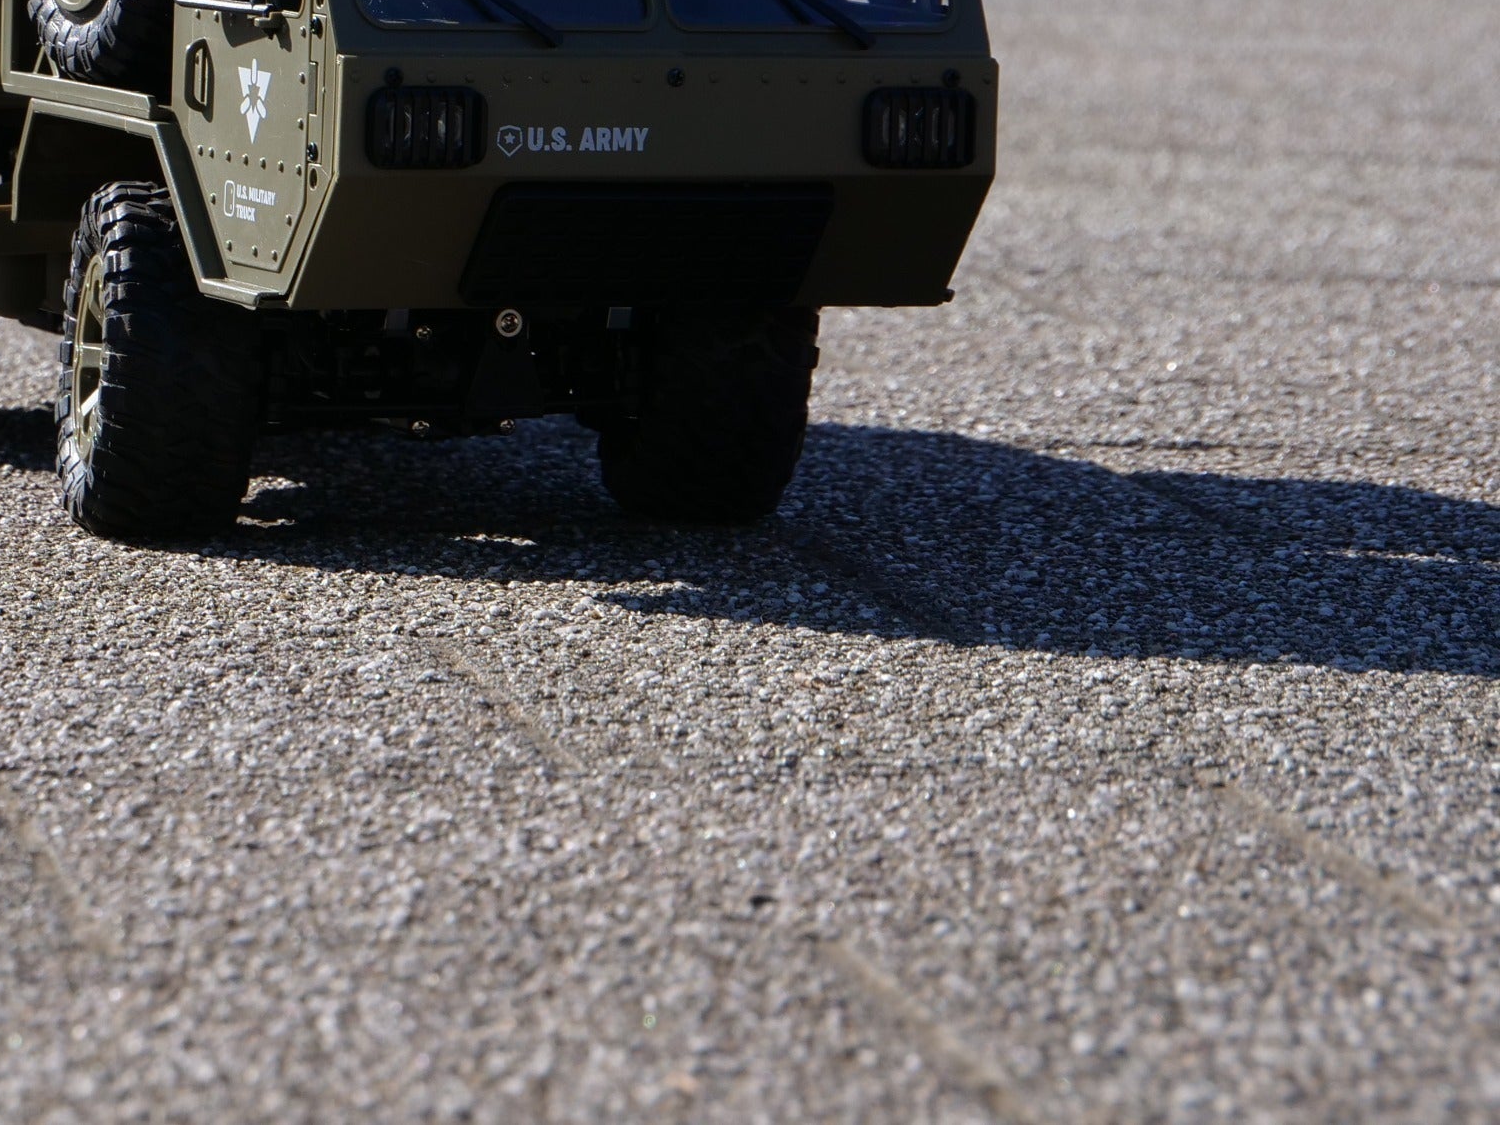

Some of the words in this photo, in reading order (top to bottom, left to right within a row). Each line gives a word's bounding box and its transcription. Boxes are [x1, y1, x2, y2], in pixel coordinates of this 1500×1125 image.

[526, 126, 572, 151] U.S.
[579, 127, 649, 152] ARMY
[236, 184, 248, 200] U.S.
[248, 187, 276, 206] MILITARY
[236, 204, 256, 222] TRUCK
